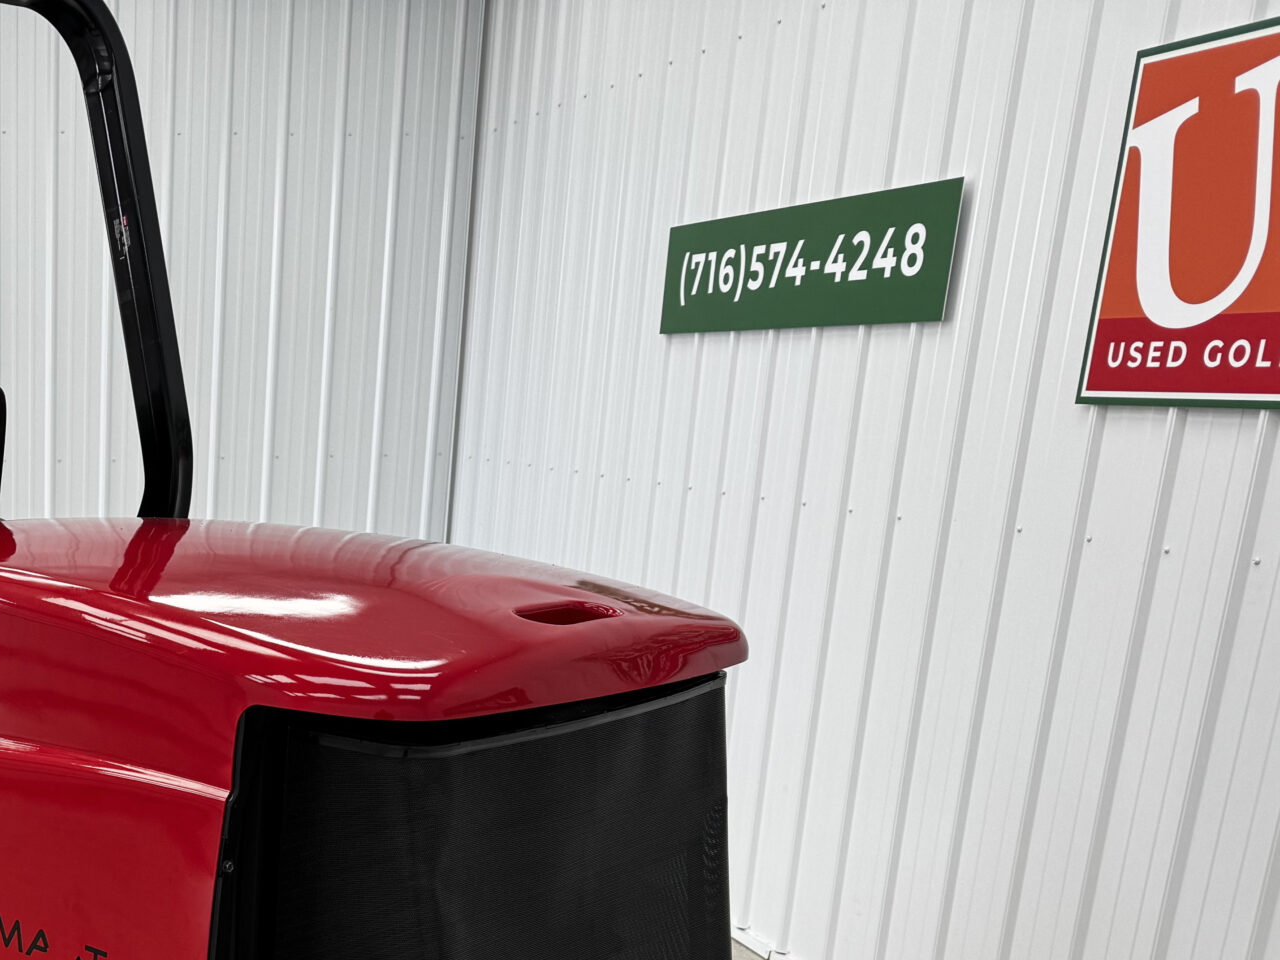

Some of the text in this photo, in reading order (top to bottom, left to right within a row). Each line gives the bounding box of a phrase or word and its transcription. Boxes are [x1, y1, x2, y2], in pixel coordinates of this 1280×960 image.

[678, 223, 927, 307] (716)574-4248
[1107, 339, 1280, 368] USED GOL
